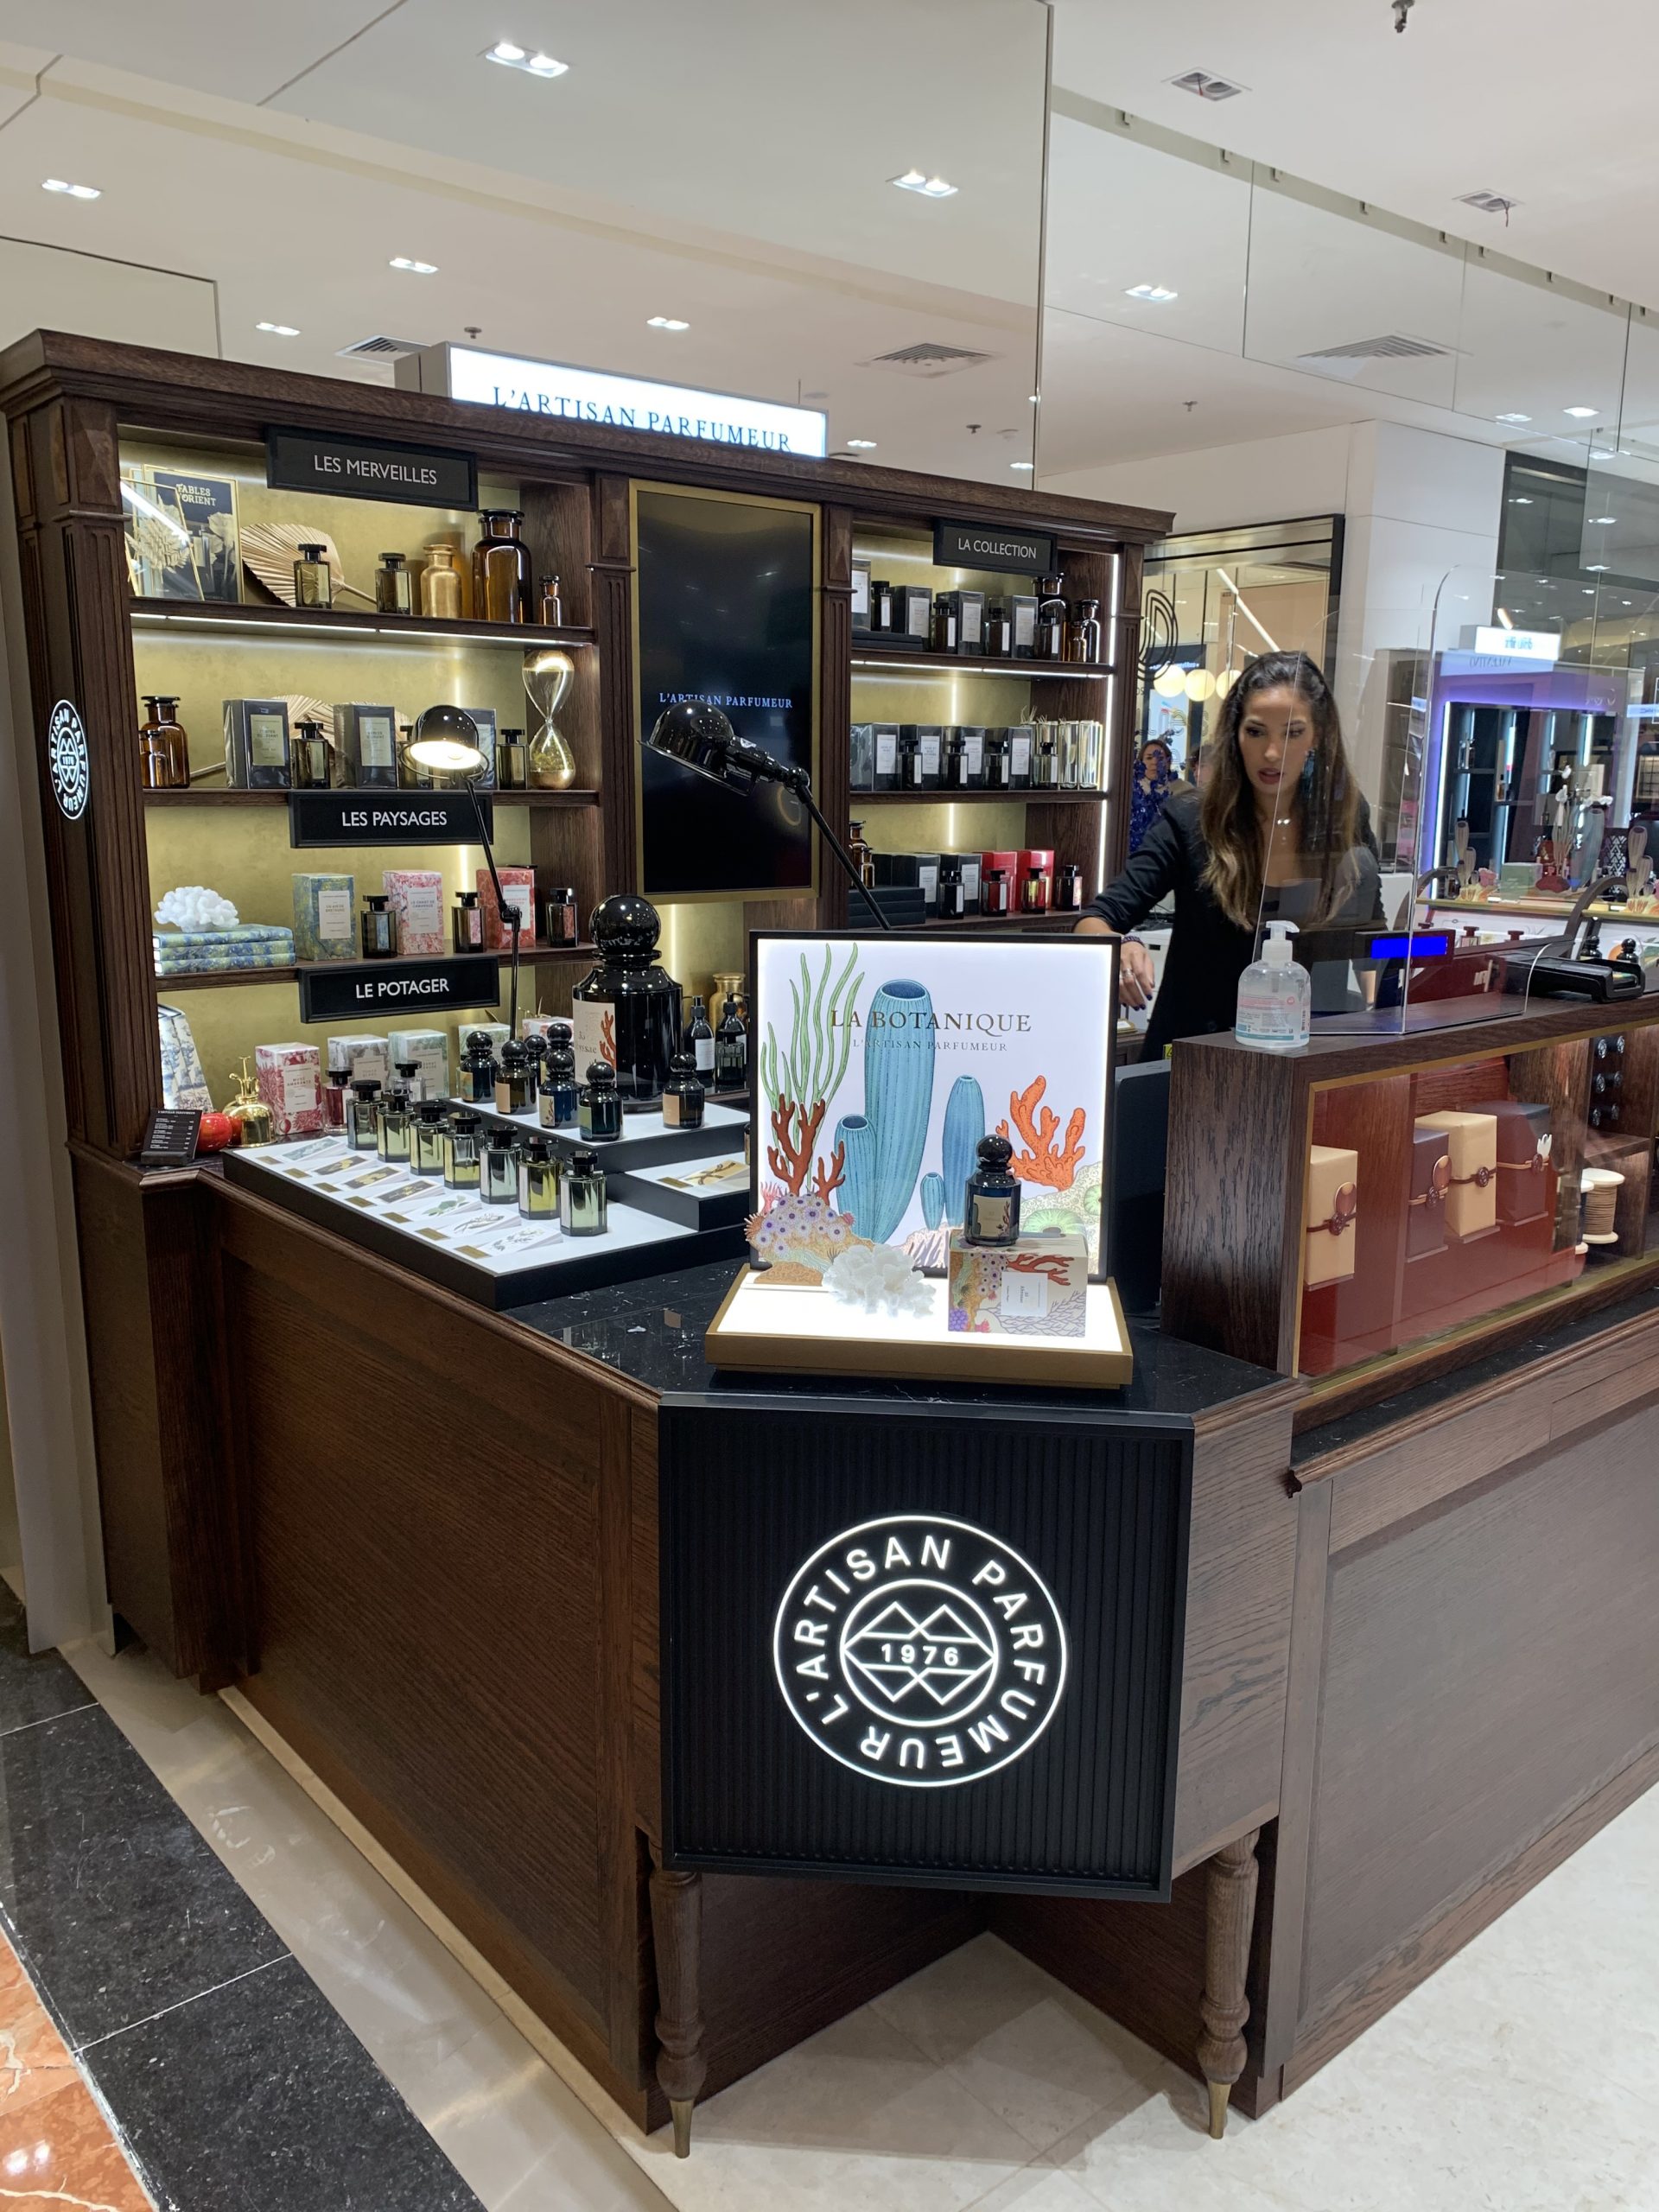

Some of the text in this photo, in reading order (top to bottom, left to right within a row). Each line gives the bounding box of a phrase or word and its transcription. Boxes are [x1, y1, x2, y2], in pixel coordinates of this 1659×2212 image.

[493, 385, 792, 452] L'ARTISAN PARFUMEUR
[314, 454, 437, 486] LES MERVEILLES
[957, 537, 1037, 559] LA COLLECTION
[726, 695, 793, 709] PARFUMEUR
[341, 810, 448, 827] LES PAYSAGES
[355, 978, 450, 999] LE POTAGER
[830, 1009, 1033, 1038] LA BOTANIQUE
[853, 1039, 1007, 1052] L'ARTISAN PARFUMEUR
[794, 1535, 1046, 1770] L'ARTISAN PARFUMEUR
[880, 1643, 959, 1666] 1976
